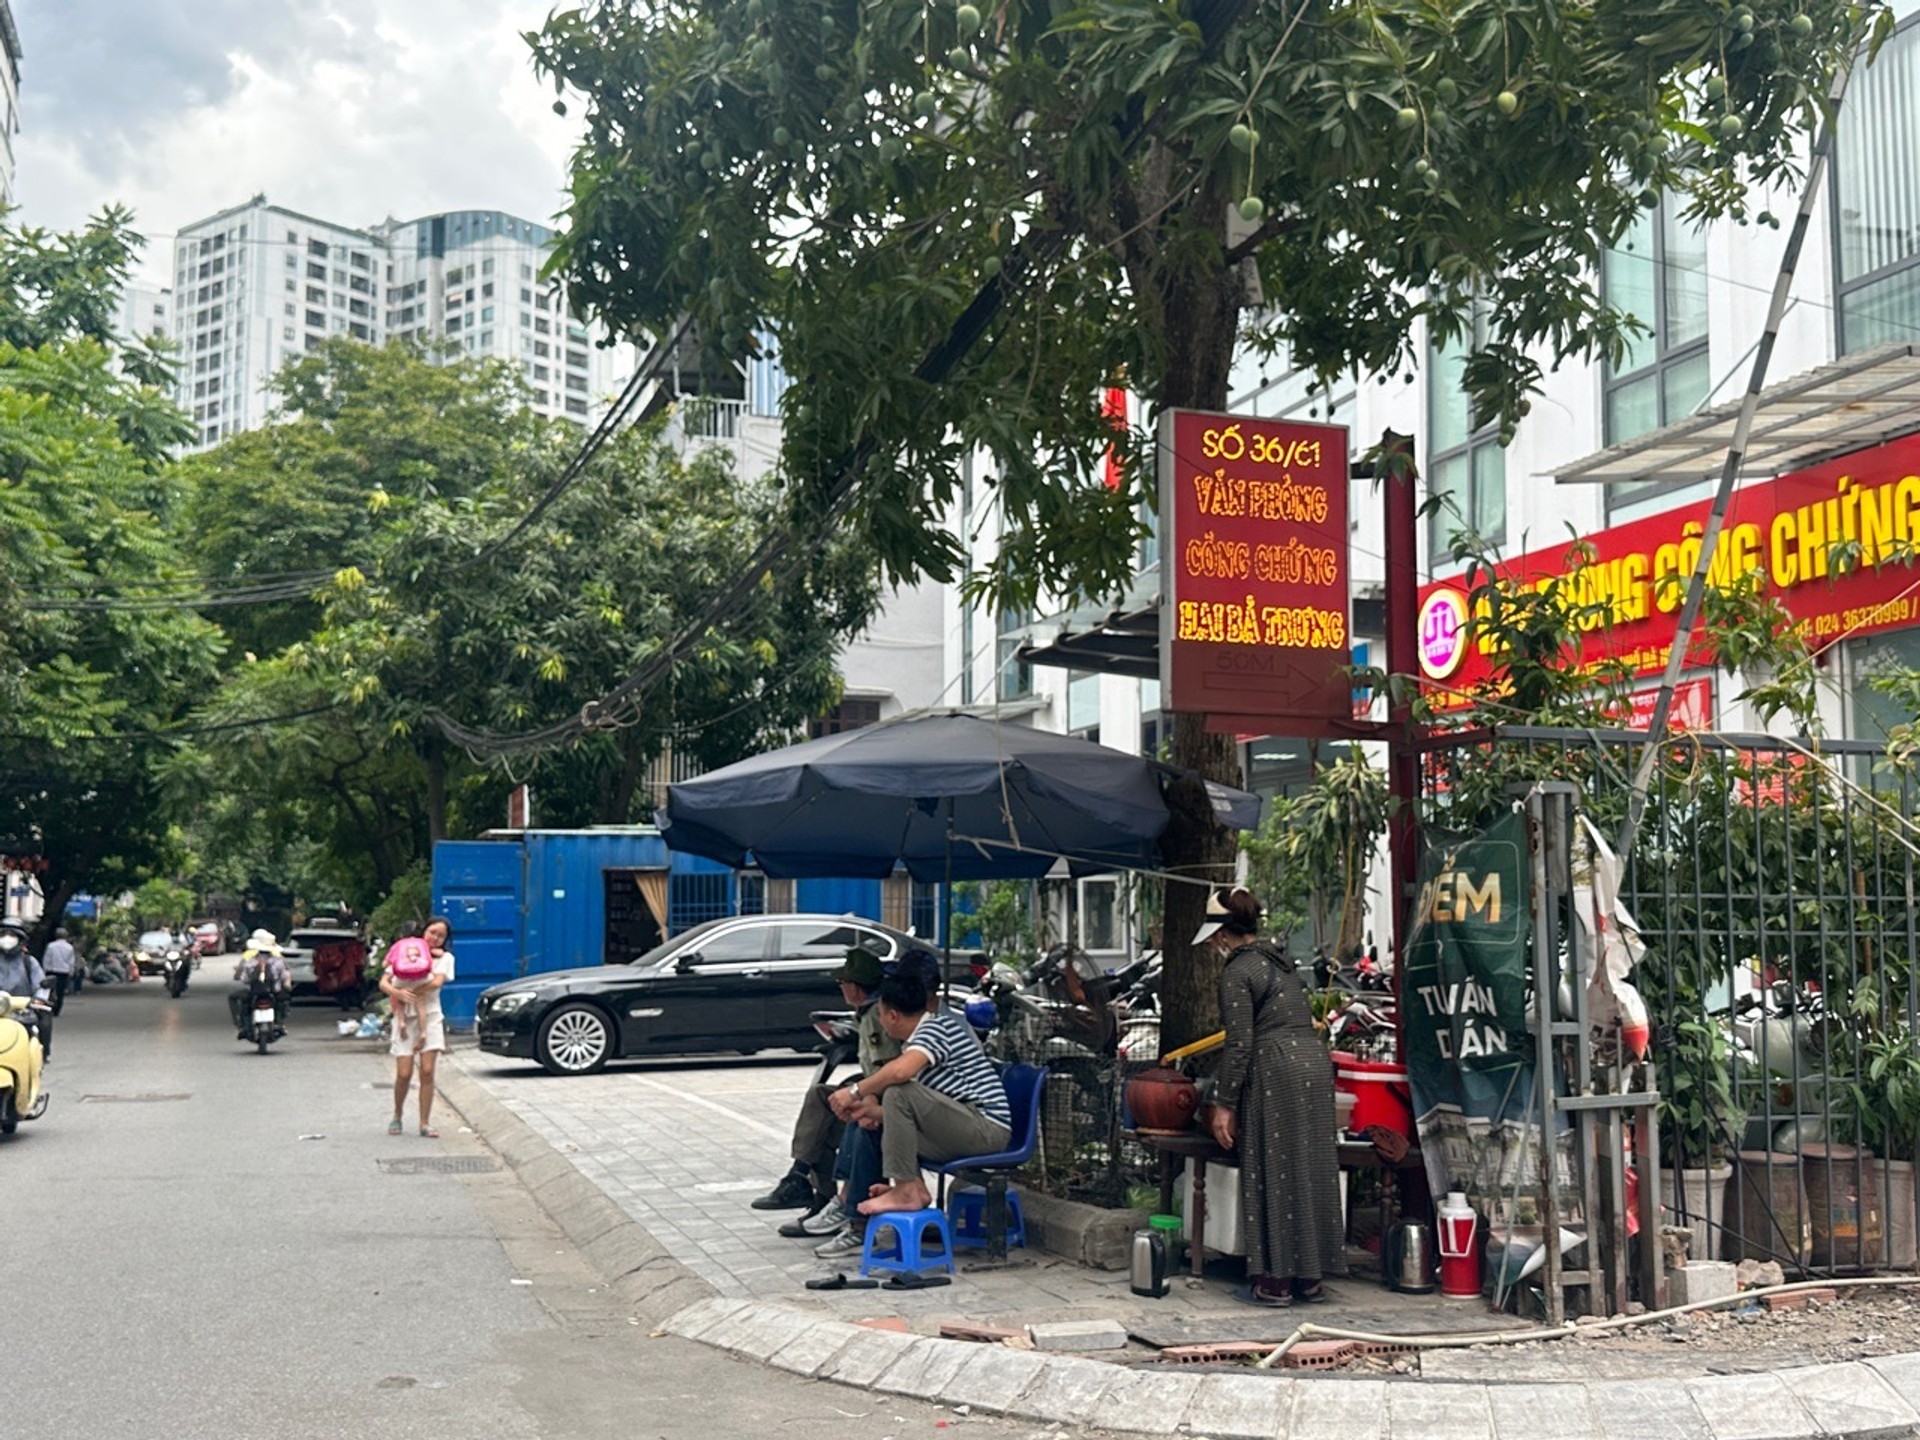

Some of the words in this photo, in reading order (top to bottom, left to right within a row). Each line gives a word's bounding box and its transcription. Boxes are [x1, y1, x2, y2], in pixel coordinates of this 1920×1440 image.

[1203, 424, 1245, 460] SỐ
[1250, 435, 1321, 468] 36/61
[1771, 475, 1920, 588] CHỨNG
[1815, 612, 1840, 636] 024
[1842, 598, 1909, 630] 36370999
